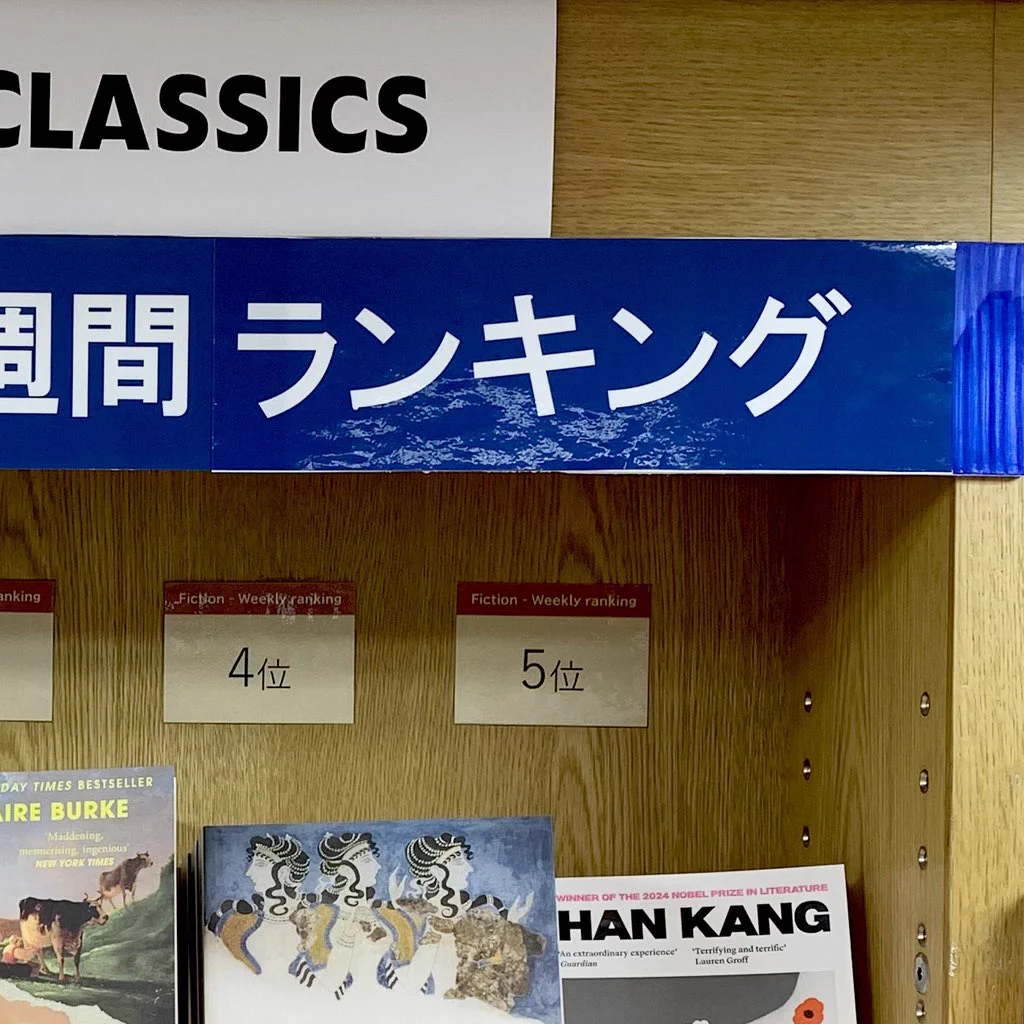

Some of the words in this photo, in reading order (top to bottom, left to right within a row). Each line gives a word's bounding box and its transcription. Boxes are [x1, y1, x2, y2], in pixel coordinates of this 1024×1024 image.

[236, 288, 852, 419] ランキング
[179, 591, 225, 605] Fiction
[238, 591, 287, 608] Weekly
[290, 591, 342, 608] ranking
[471, 593, 518, 607] Fiction
[531, 594, 581, 610] Weekly
[585, 594, 637, 610] ranking
[228, 646, 291, 691] 4位
[521, 648, 584, 693] 5位
[33, 780, 72, 792] TIMES
[78, 777, 153, 790] BESTSELLER
[51, 799, 129, 821] BURKE
[35, 859, 58, 868] NEW
[60, 859, 85, 868] YORK
[88, 857, 115, 867] TIMES
[619, 893, 640, 901] THE
[643, 892, 669, 900] 2024
[672, 890, 708, 899] NOBEL
[711, 889, 744, 897] PRIZE
[746, 888, 757, 896] IN
[760, 884, 828, 895] LITERATURE
[558, 908, 667, 941] HAN
[680, 900, 831, 938] KANG
[573, 949, 628, 958] extraordinary
[738, 945, 753, 953] and
[560, 960, 598, 968] Guardian
[727, 956, 749, 964] Groff
